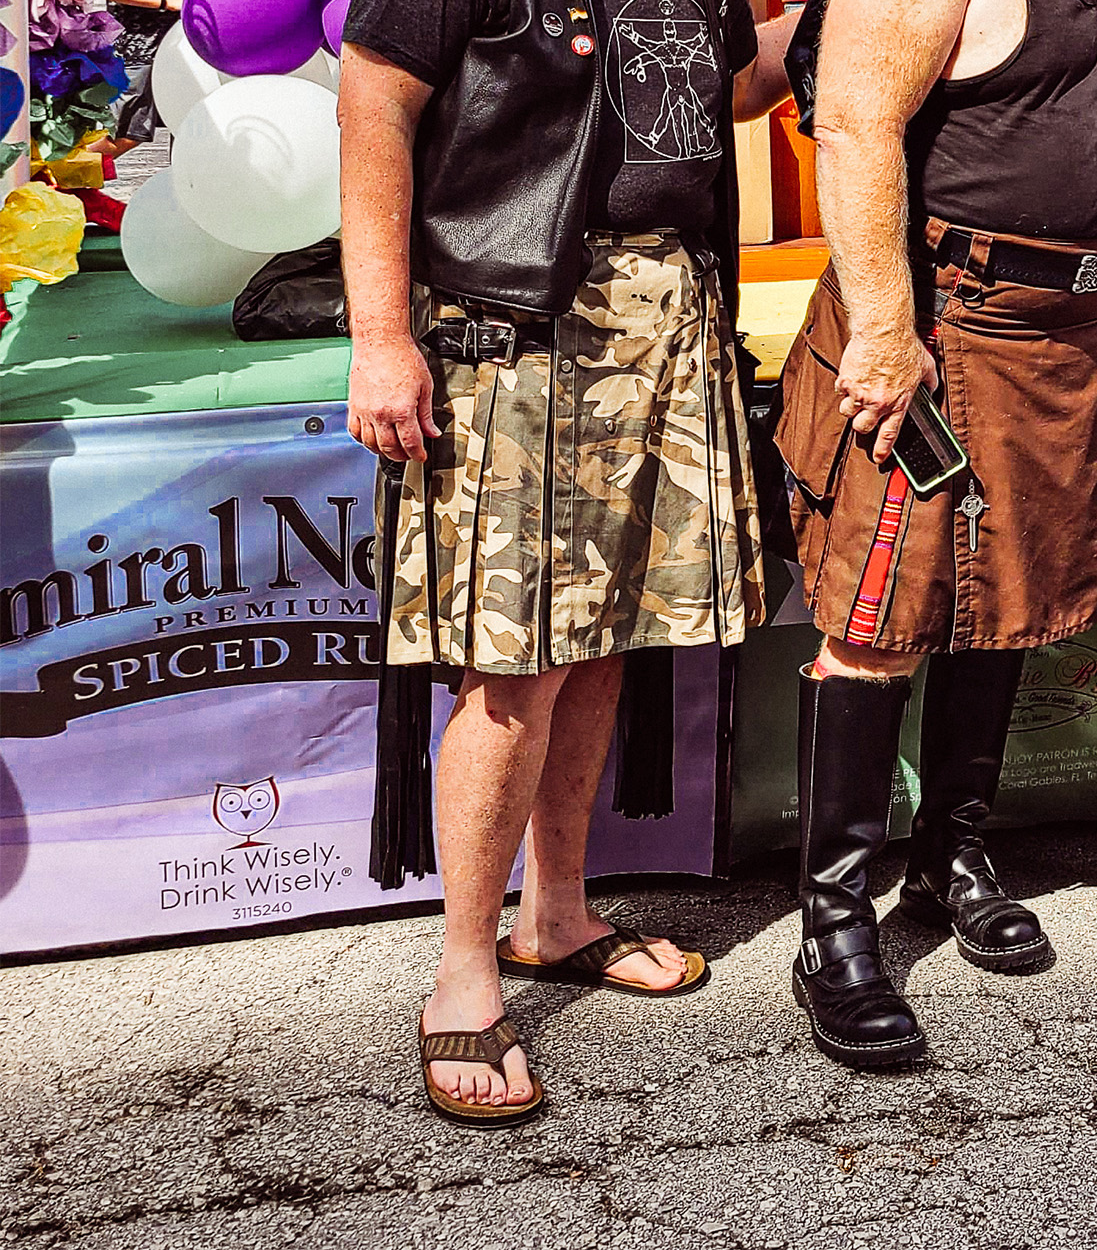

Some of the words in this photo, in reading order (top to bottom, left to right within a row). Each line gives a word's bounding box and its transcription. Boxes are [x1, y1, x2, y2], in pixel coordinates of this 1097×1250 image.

[154, 598, 370, 635] PREMIUM
[72, 637, 291, 701] SPICED
[158, 854, 236, 883] Think
[244, 842, 341, 871] Wisely.
[161, 881, 237, 910] Drink
[232, 901, 293, 920] 3115240
